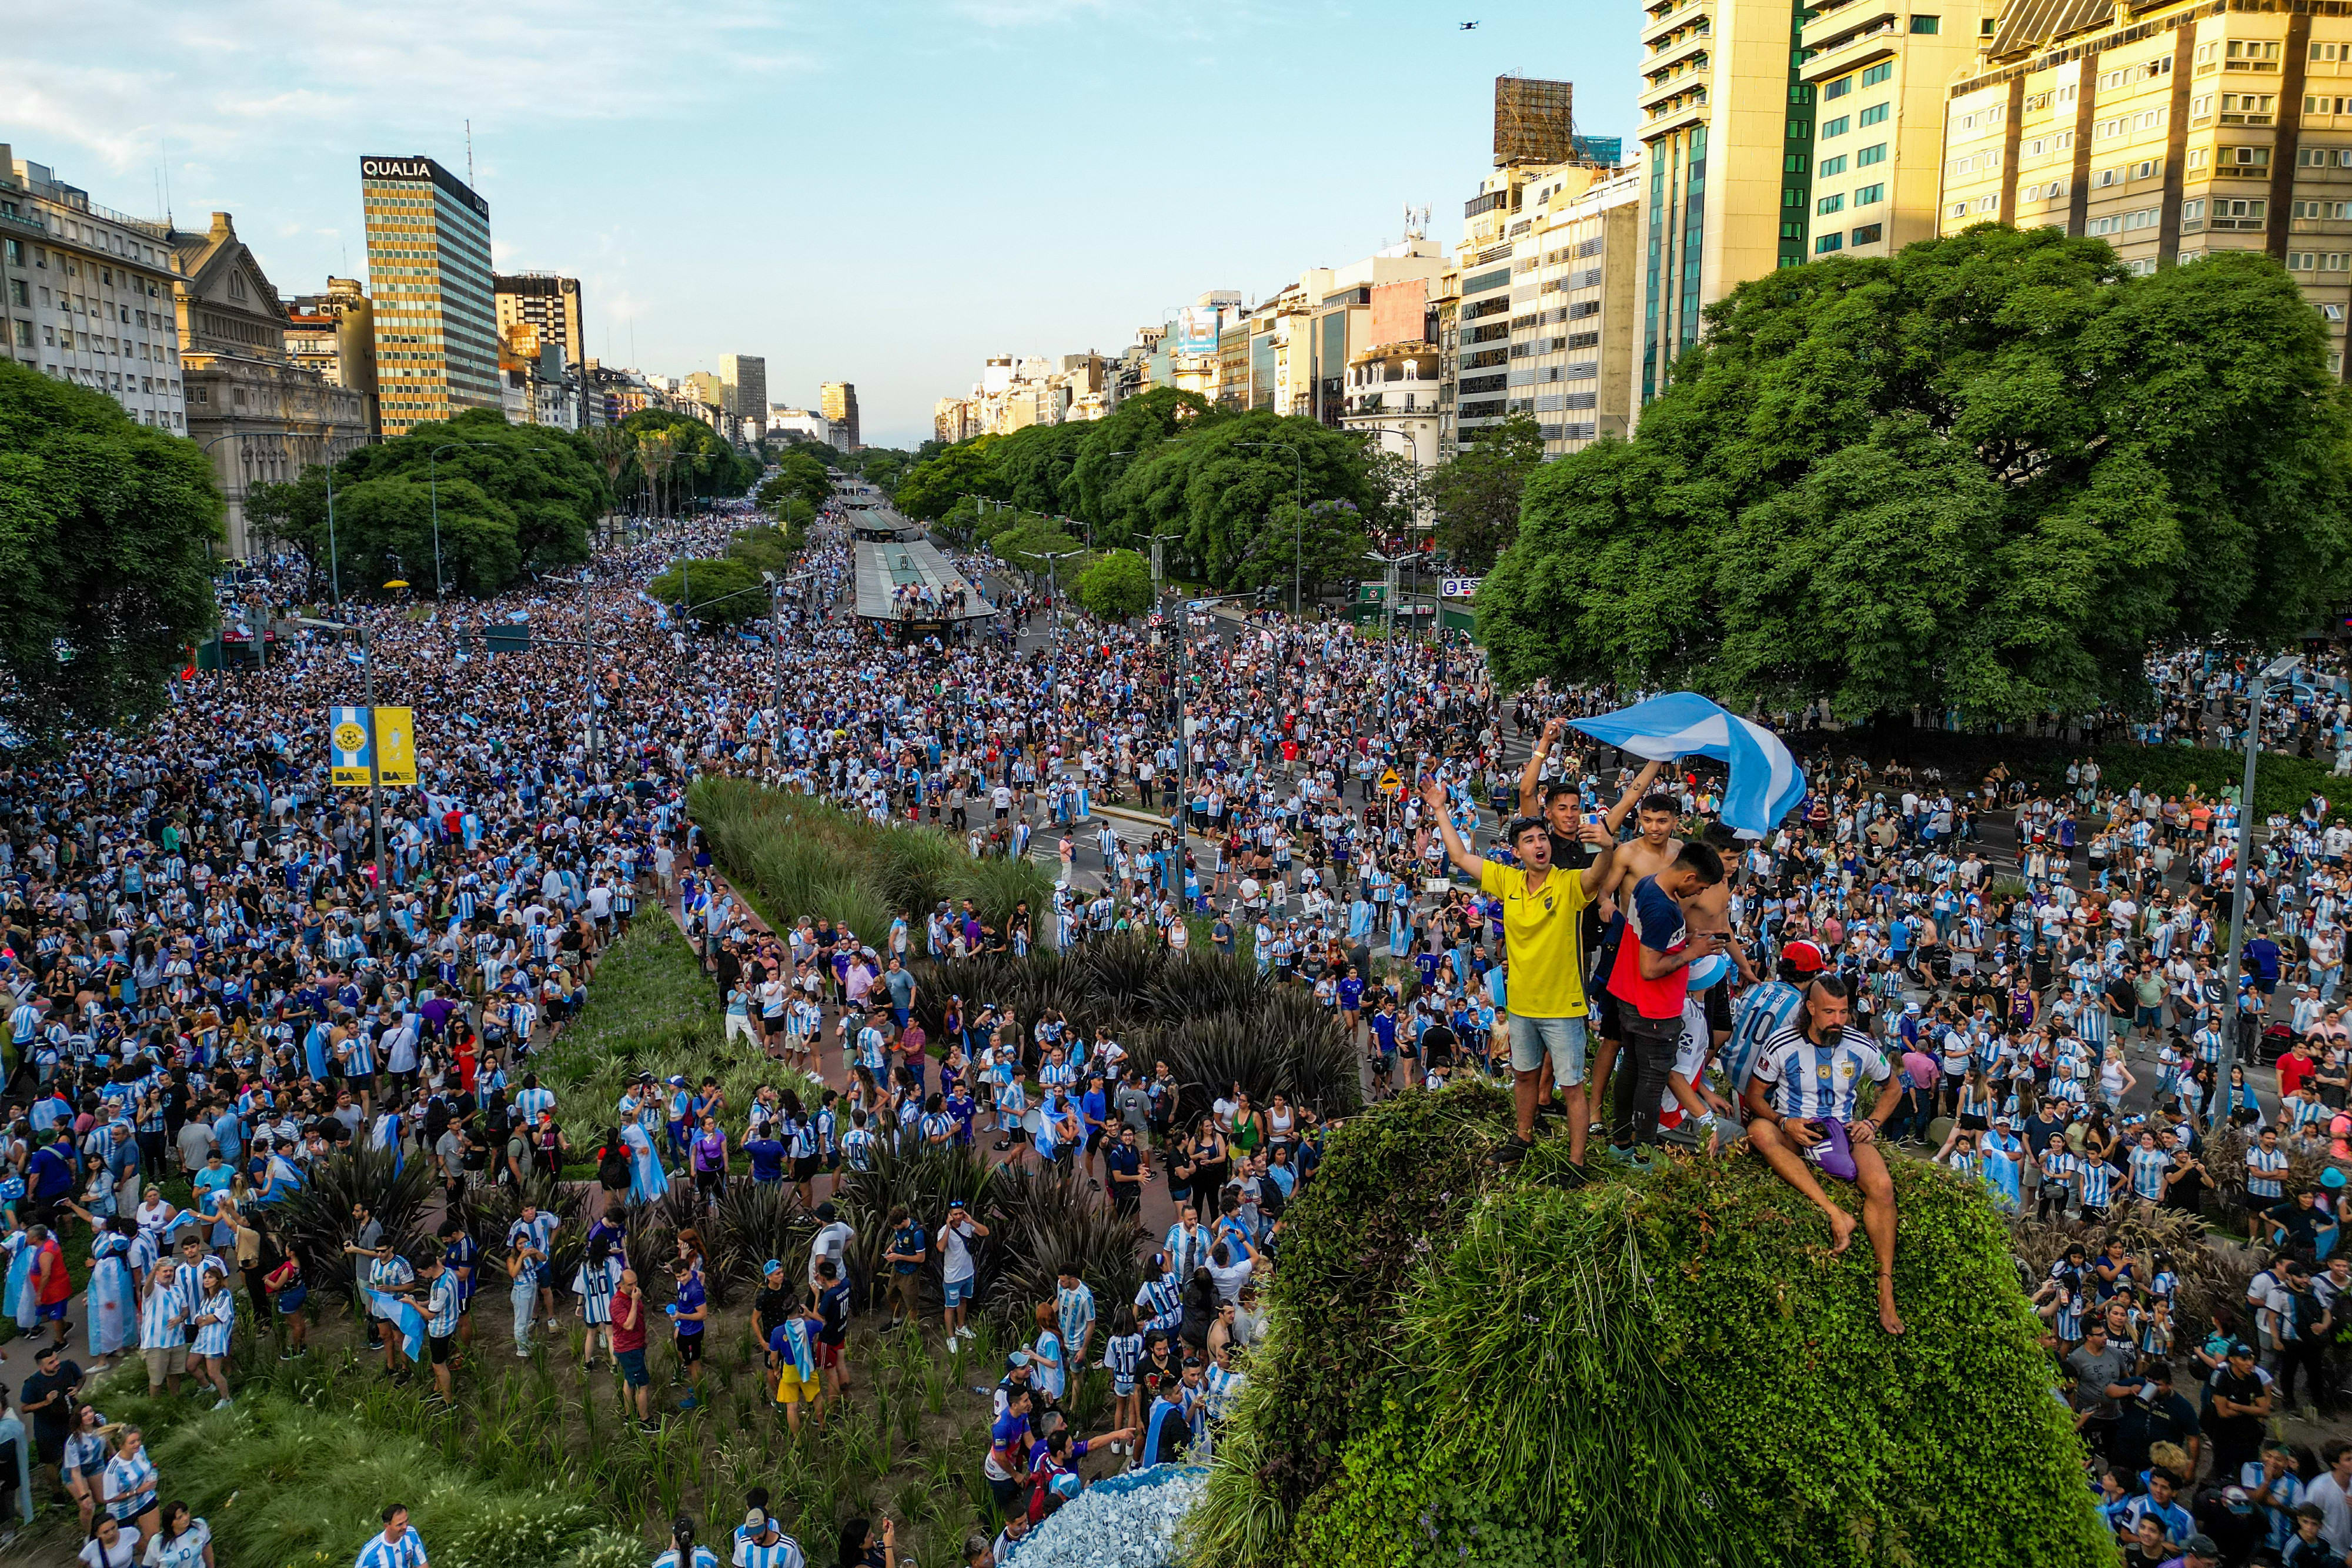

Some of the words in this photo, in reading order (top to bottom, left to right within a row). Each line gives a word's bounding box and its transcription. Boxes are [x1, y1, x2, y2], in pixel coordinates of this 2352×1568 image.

[363, 161, 431, 177] QUALIA
[336, 738, 364, 751] MUNDIAL
[336, 771, 355, 781] BA
[382, 771, 401, 781] BA
[1339, 842, 1348, 852] 10
[534, 933, 546, 945] 10
[479, 942, 490, 953] 10
[1420, 959, 1431, 972] 10
[1760, 990, 1786, 1005] MESSI
[1742, 1007, 1775, 1045] 10
[69, 1044, 84, 1057] 10
[1818, 1089, 1835, 1107] 10
[848, 1142, 863, 1161] 10
[589, 1275, 609, 1297] 10
[839, 1296, 849, 1319] 10
[1154, 1286, 1180, 1315] 10
[1063, 1305, 1068, 1316] 10
[1115, 1351, 1137, 1376] 10
[178, 1547, 191, 1562] 10
